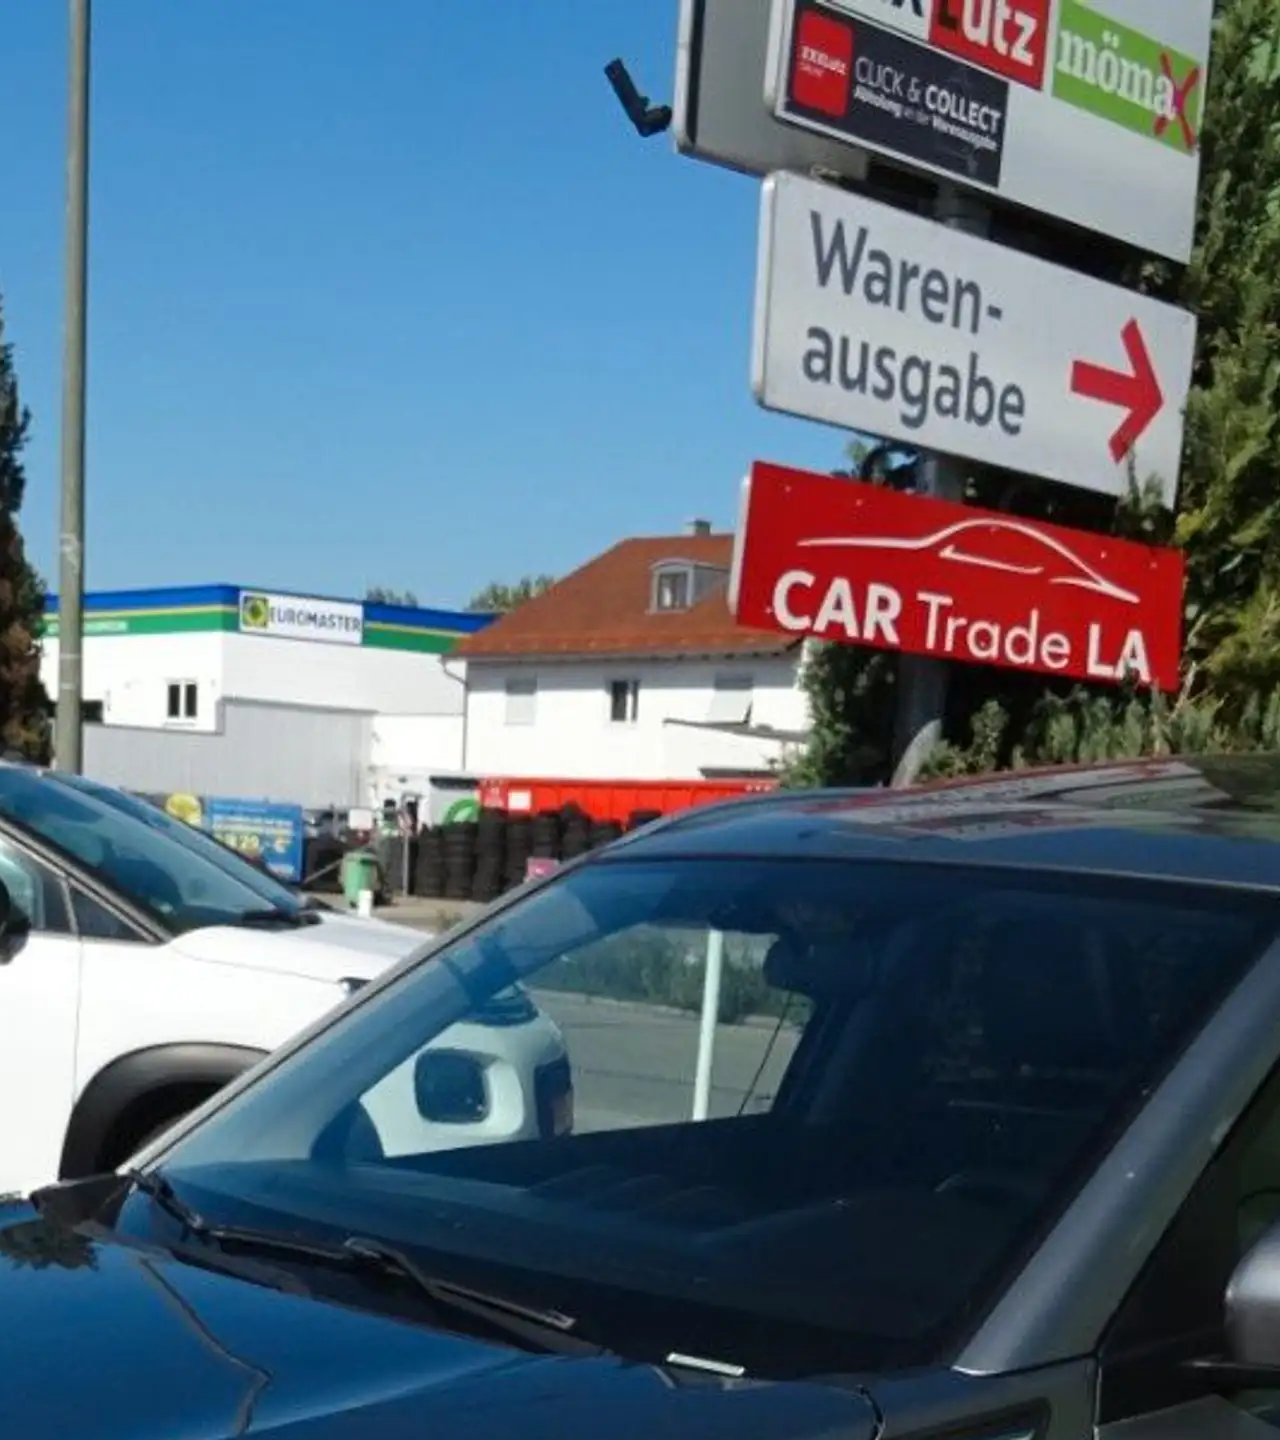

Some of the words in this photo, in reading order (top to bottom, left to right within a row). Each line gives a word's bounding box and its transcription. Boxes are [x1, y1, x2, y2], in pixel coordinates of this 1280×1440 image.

[854, 56, 905, 97] CLICK
[907, 77, 921, 103] &
[925, 84, 1002, 134] COLLECT
[810, 210, 1003, 334] Waren-
[803, 326, 1025, 435] ausgabe
[269, 606, 361, 633] EUROMASTER
[772, 570, 902, 645] CAR
[917, 593, 1070, 668] Trade
[1086, 623, 1151, 681] LA
